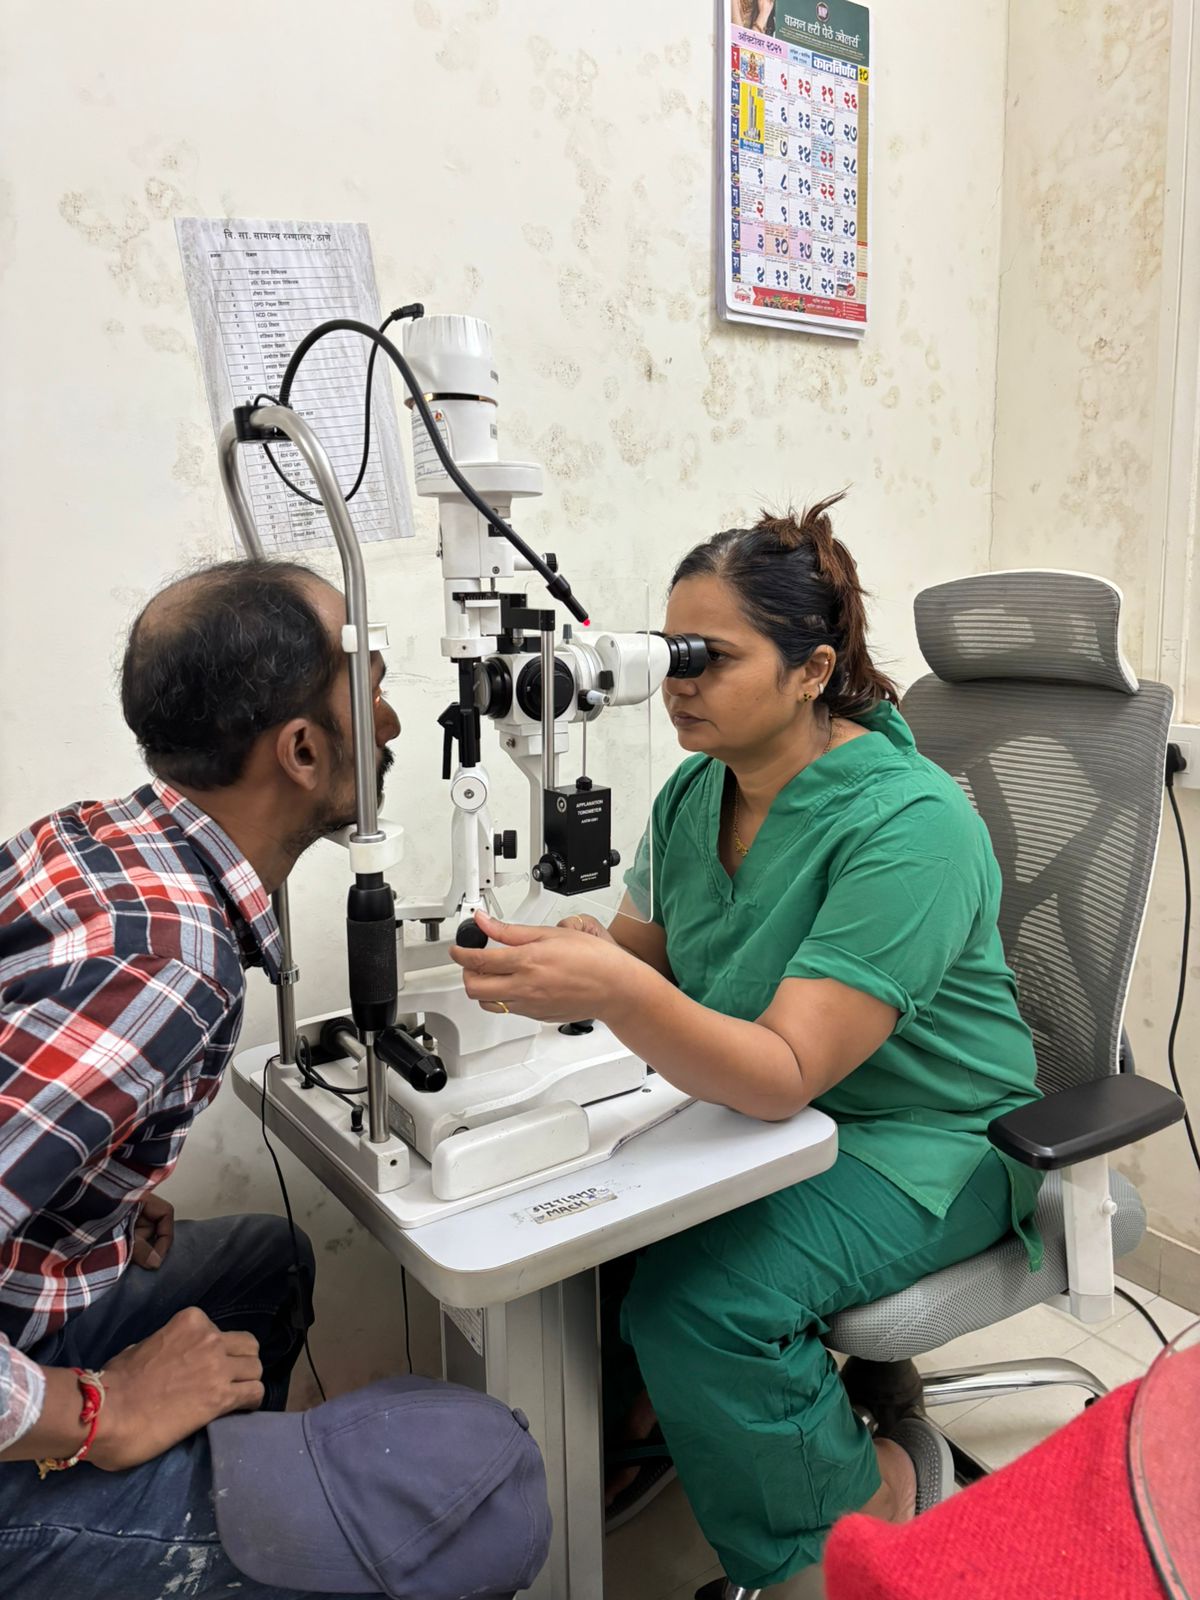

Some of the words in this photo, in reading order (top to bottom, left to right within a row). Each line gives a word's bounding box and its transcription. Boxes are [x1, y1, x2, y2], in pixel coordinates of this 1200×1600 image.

[784, 14, 806, 32] वामन
[808, 22, 820, 36] हरी
[822, 24, 833, 40] पेठे
[835, 29, 858, 48] ज्वेलर्स
[814, 56, 856, 80] कालनिर्णय
[858, 68, 868, 80] १०
[780, 73, 787, 89] ५
[798, 79, 811, 97] १२
[822, 86, 834, 104] १९
[844, 92, 857, 109] २६
[781, 107, 787, 123] ६
[798, 112, 810, 130] १३
[821, 118, 834, 136] २०
[844, 124, 857, 142] २७
[780, 140, 788, 156] ७
[798, 145, 811, 162] १४
[821, 151, 833, 168] २१
[844, 156, 856, 174] २८
[758, 168, 763, 184] १
[781, 174, 787, 190] ८
[799, 178, 811, 195] १५
[821, 183, 834, 200] २२
[844, 188, 856, 205] २९
[757, 201, 764, 218] २
[781, 206, 787, 222] ९
[799, 210, 811, 226] १६
[821, 215, 833, 231] २३
[843, 220, 856, 236] ३०
[224, 228, 236, 239] वि.
[254, 232, 280, 241] सामान्य
[316, 232, 331, 242] ठाणे
[758, 234, 764, 250] ३
[775, 238, 789, 254] १०
[800, 242, 812, 259] १७
[821, 246, 834, 264] २४
[843, 251, 855, 267] ३१
[757, 266, 765, 283] ४
[776, 270, 788, 286] ११
[800, 274, 812, 291] १८
[822, 278, 834, 294] २५
[576, 800, 603, 808] APPLANATION
[578, 807, 602, 816] TONOMETER
[546, 1200, 590, 1216] MACH
